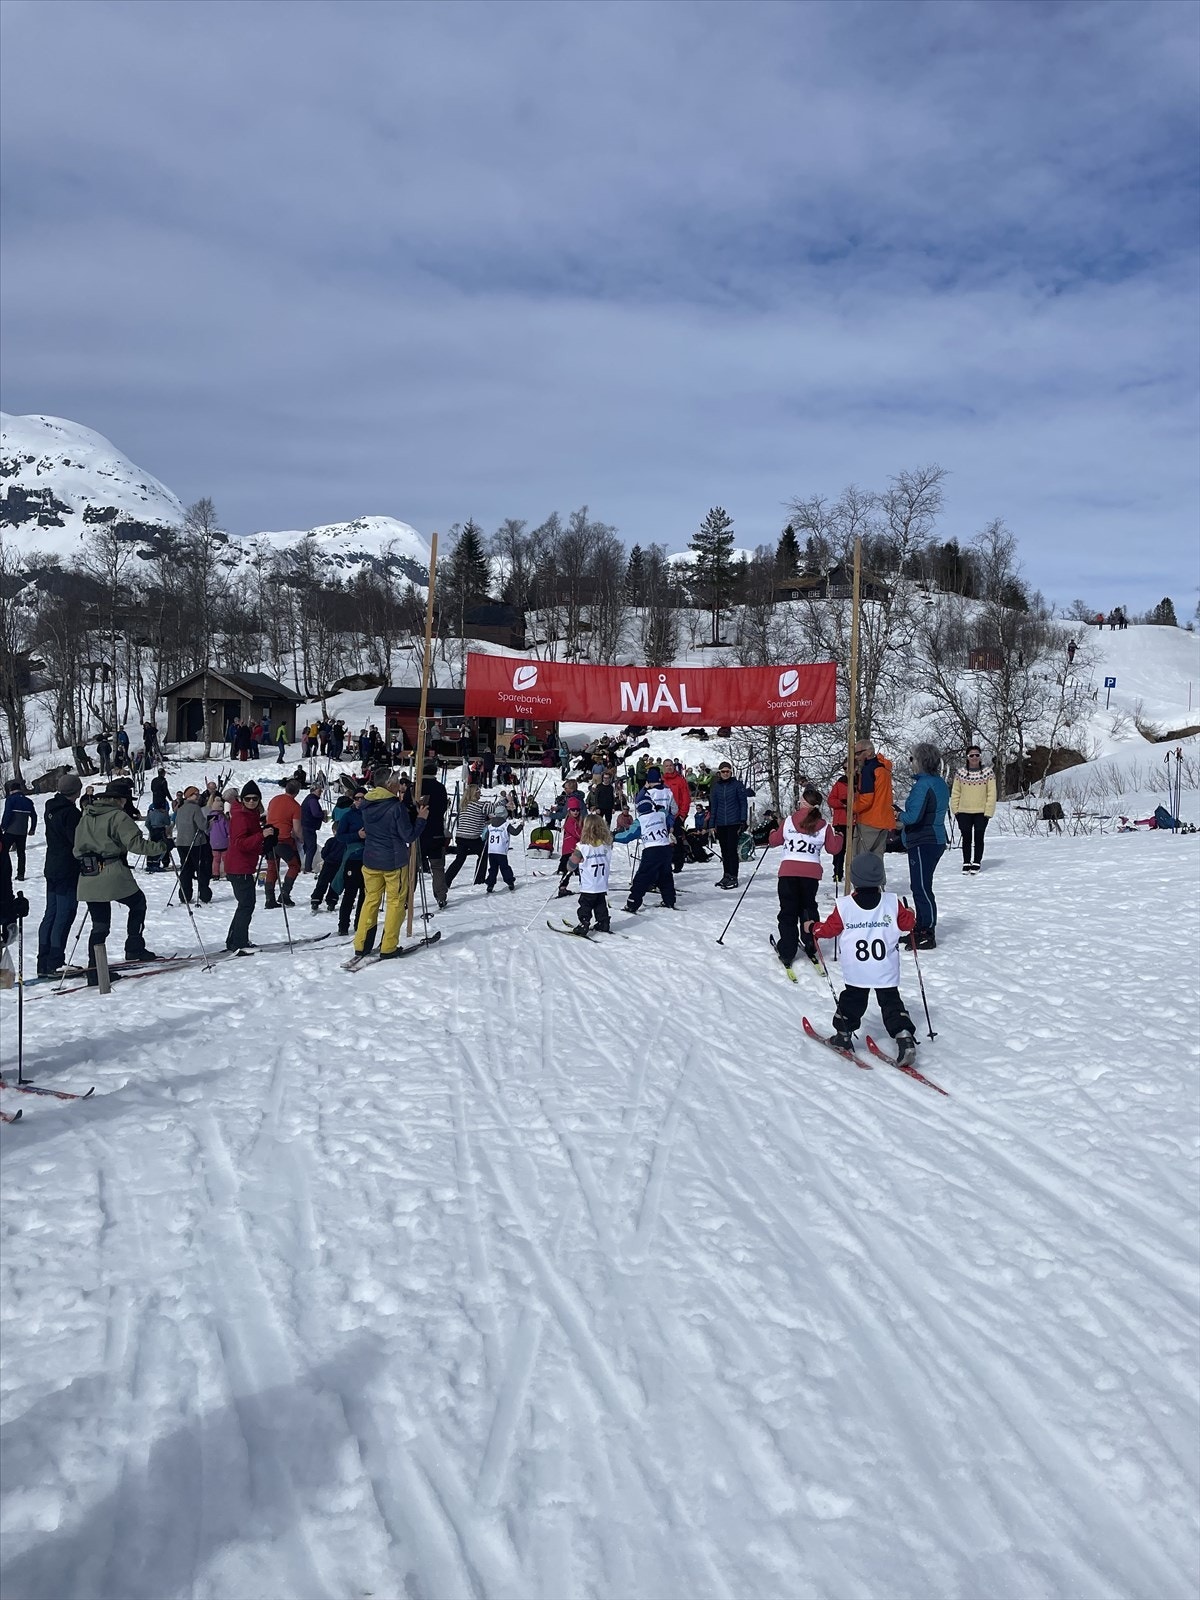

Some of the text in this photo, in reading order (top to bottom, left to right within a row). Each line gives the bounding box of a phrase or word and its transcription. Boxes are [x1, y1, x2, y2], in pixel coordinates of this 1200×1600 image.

[1107, 678, 1114, 687] P
[498, 691, 552, 705] Sparebanken
[620, 673, 702, 713] MÅL
[514, 704, 533, 714] Vest
[766, 699, 813, 710] Sparebanken
[782, 710, 799, 719] Vest
[489, 834, 500, 844] 81
[590, 863, 606, 878] 77
[845, 920, 890, 930] Saudefaldene
[855, 938, 886, 962] 80
